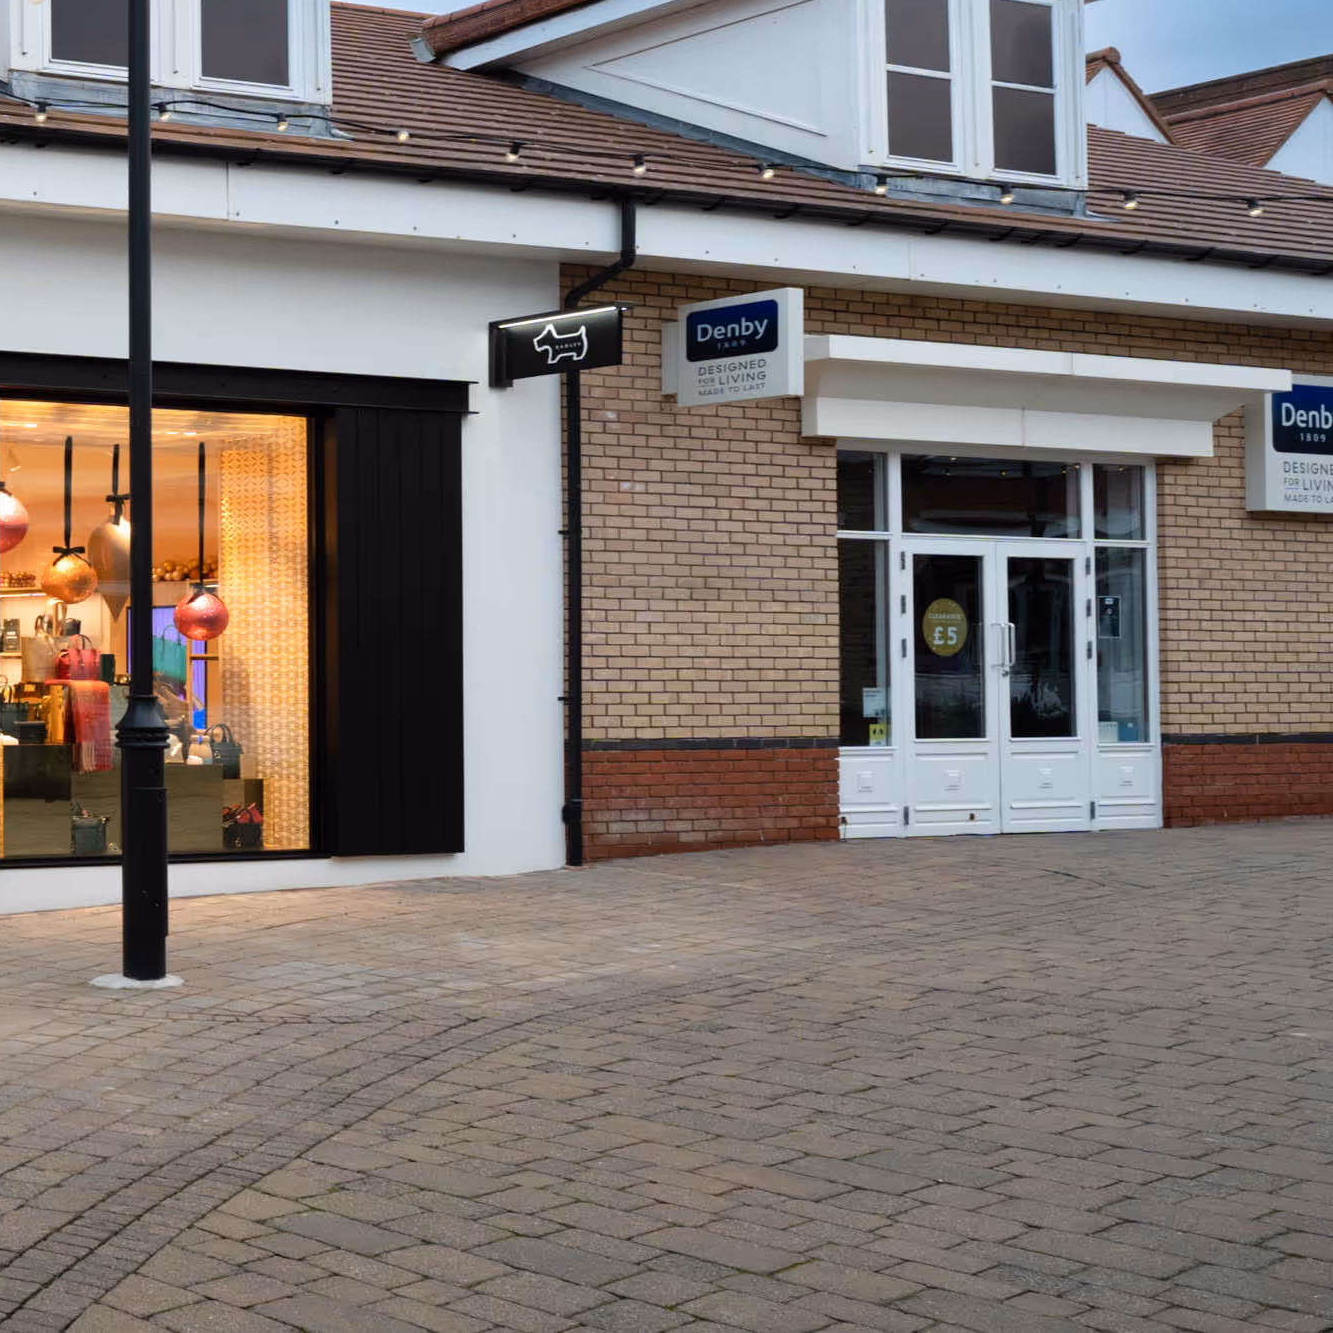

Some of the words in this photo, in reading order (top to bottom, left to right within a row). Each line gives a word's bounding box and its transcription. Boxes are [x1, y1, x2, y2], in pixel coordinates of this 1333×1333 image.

[697, 317, 768, 342] Denby
[698, 359, 766, 376] DESIGNED
[698, 377, 716, 385] FOR
[719, 371, 766, 385] LIVING
[698, 388, 726, 396] MADE
[728, 385, 740, 393] TO
[743, 383, 765, 391] LAST
[1281, 402, 1333, 429] Denb
[1300, 433, 1326, 443] 1809
[1284, 477, 1300, 486] FOR
[1284, 493, 1309, 504] MADE
[1311, 494, 1322, 504] TO
[933, 626, 958, 646] £5
